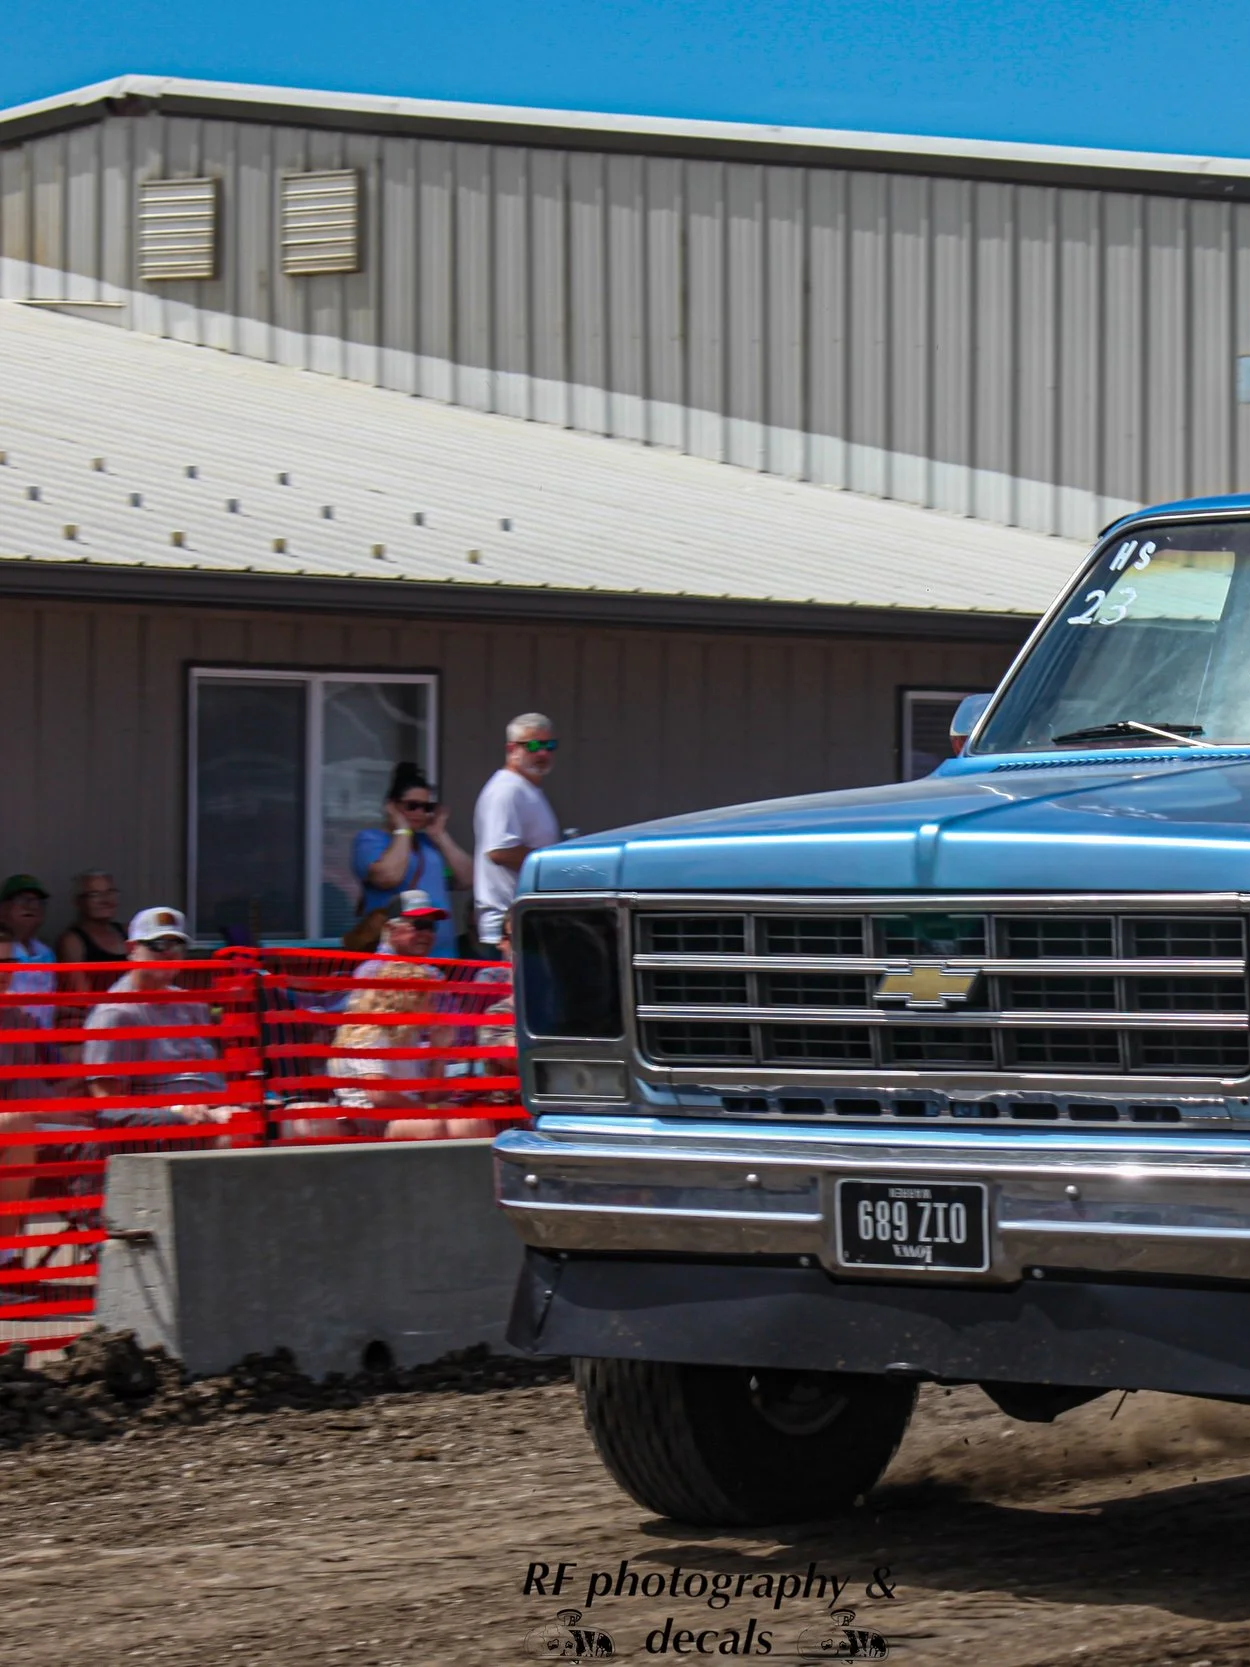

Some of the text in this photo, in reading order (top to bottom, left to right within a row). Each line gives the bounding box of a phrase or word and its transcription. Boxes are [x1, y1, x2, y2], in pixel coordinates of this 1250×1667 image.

[1109, 540, 1156, 571] HS
[1067, 587, 1137, 625] 23
[857, 1200, 909, 1241] 689
